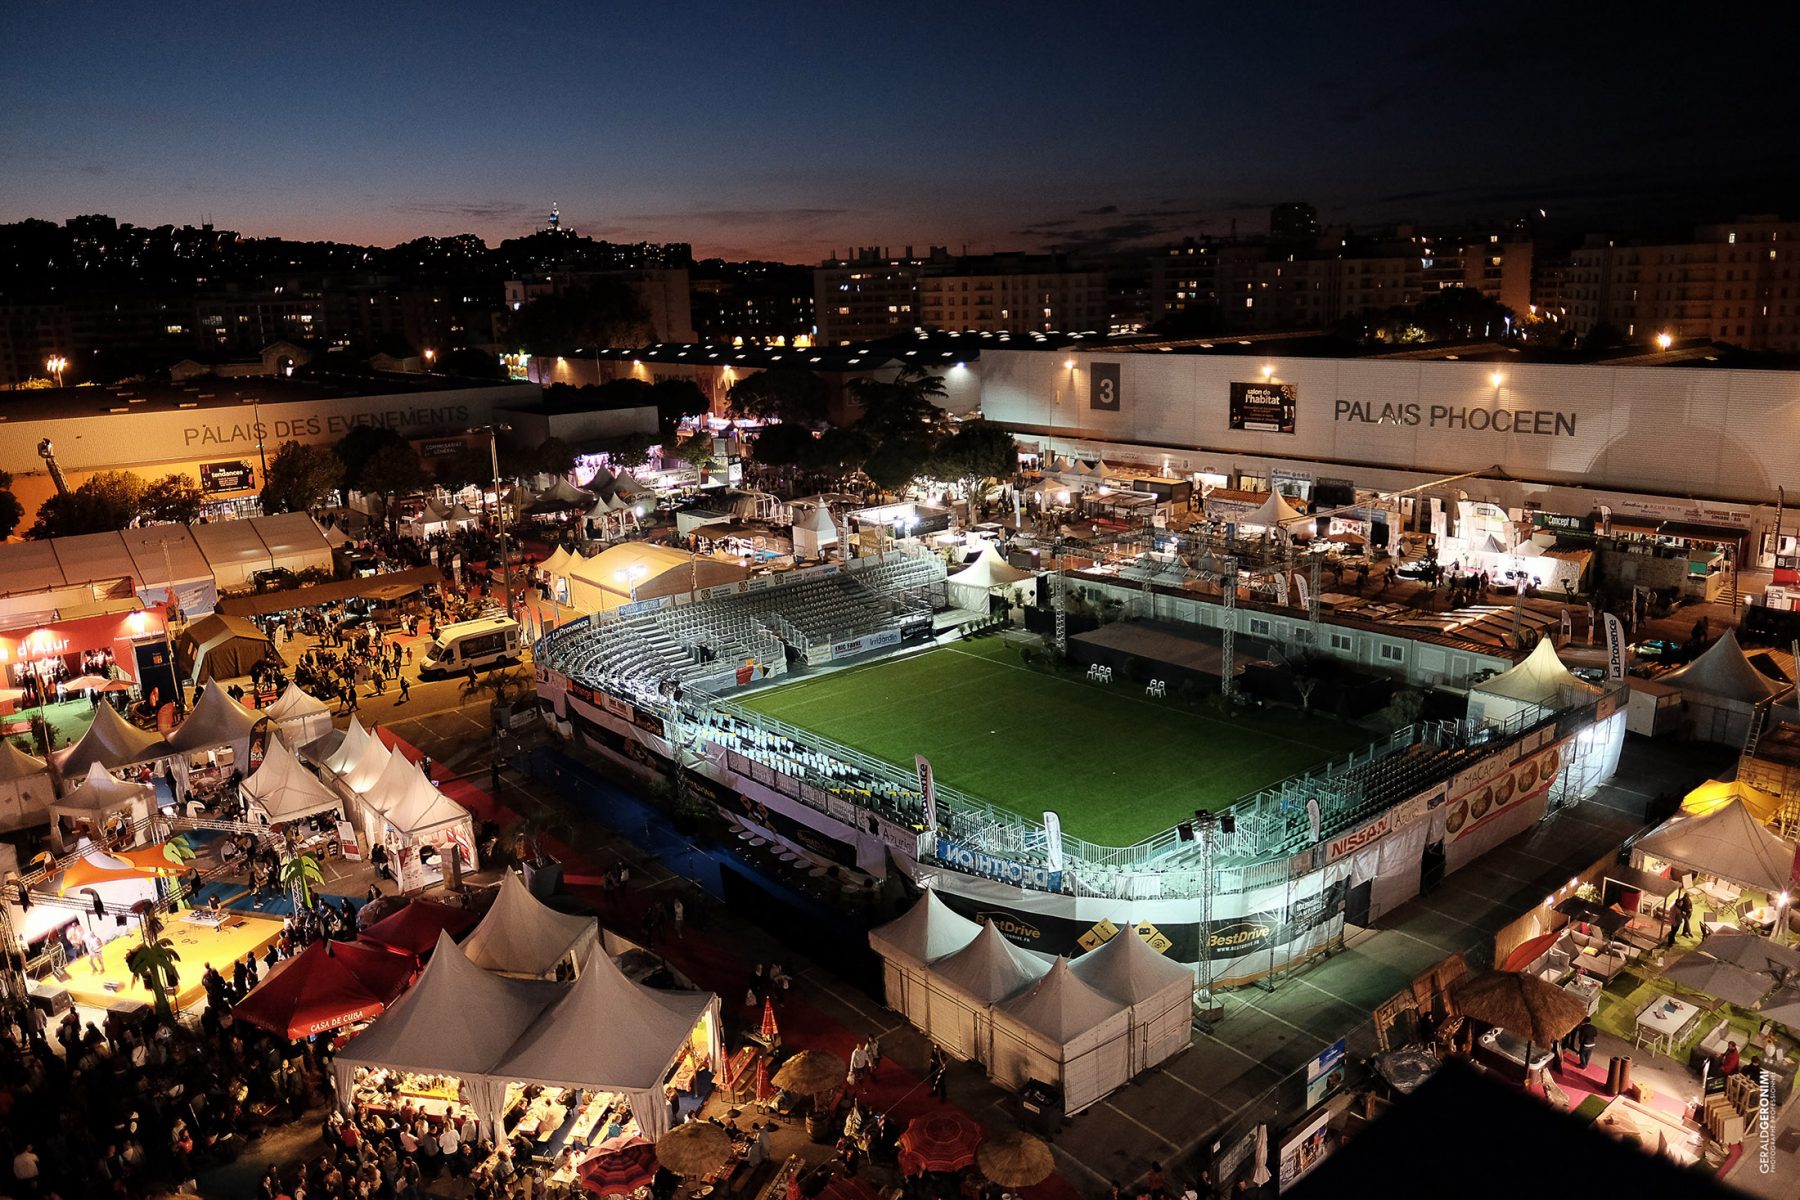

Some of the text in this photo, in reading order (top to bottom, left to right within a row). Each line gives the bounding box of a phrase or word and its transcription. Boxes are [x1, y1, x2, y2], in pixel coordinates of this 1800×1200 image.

[1100, 378, 1114, 404] 3
[1245, 394, 1280, 405] l'habitat
[184, 406, 469, 446] PALAIS DES EVENEMENTS
[1334, 400, 1576, 437] PALAIS PHOCEEN
[211, 470, 243, 478] tendances
[1548, 515, 1580, 528] Concept Alu
[552, 619, 590, 641] La Provence
[1610, 619, 1621, 678] La Provence
[1331, 818, 1388, 858] NISSAN
[1208, 926, 1270, 947] BestDrive
[310, 1010, 364, 1033] CASA DE CUBA
